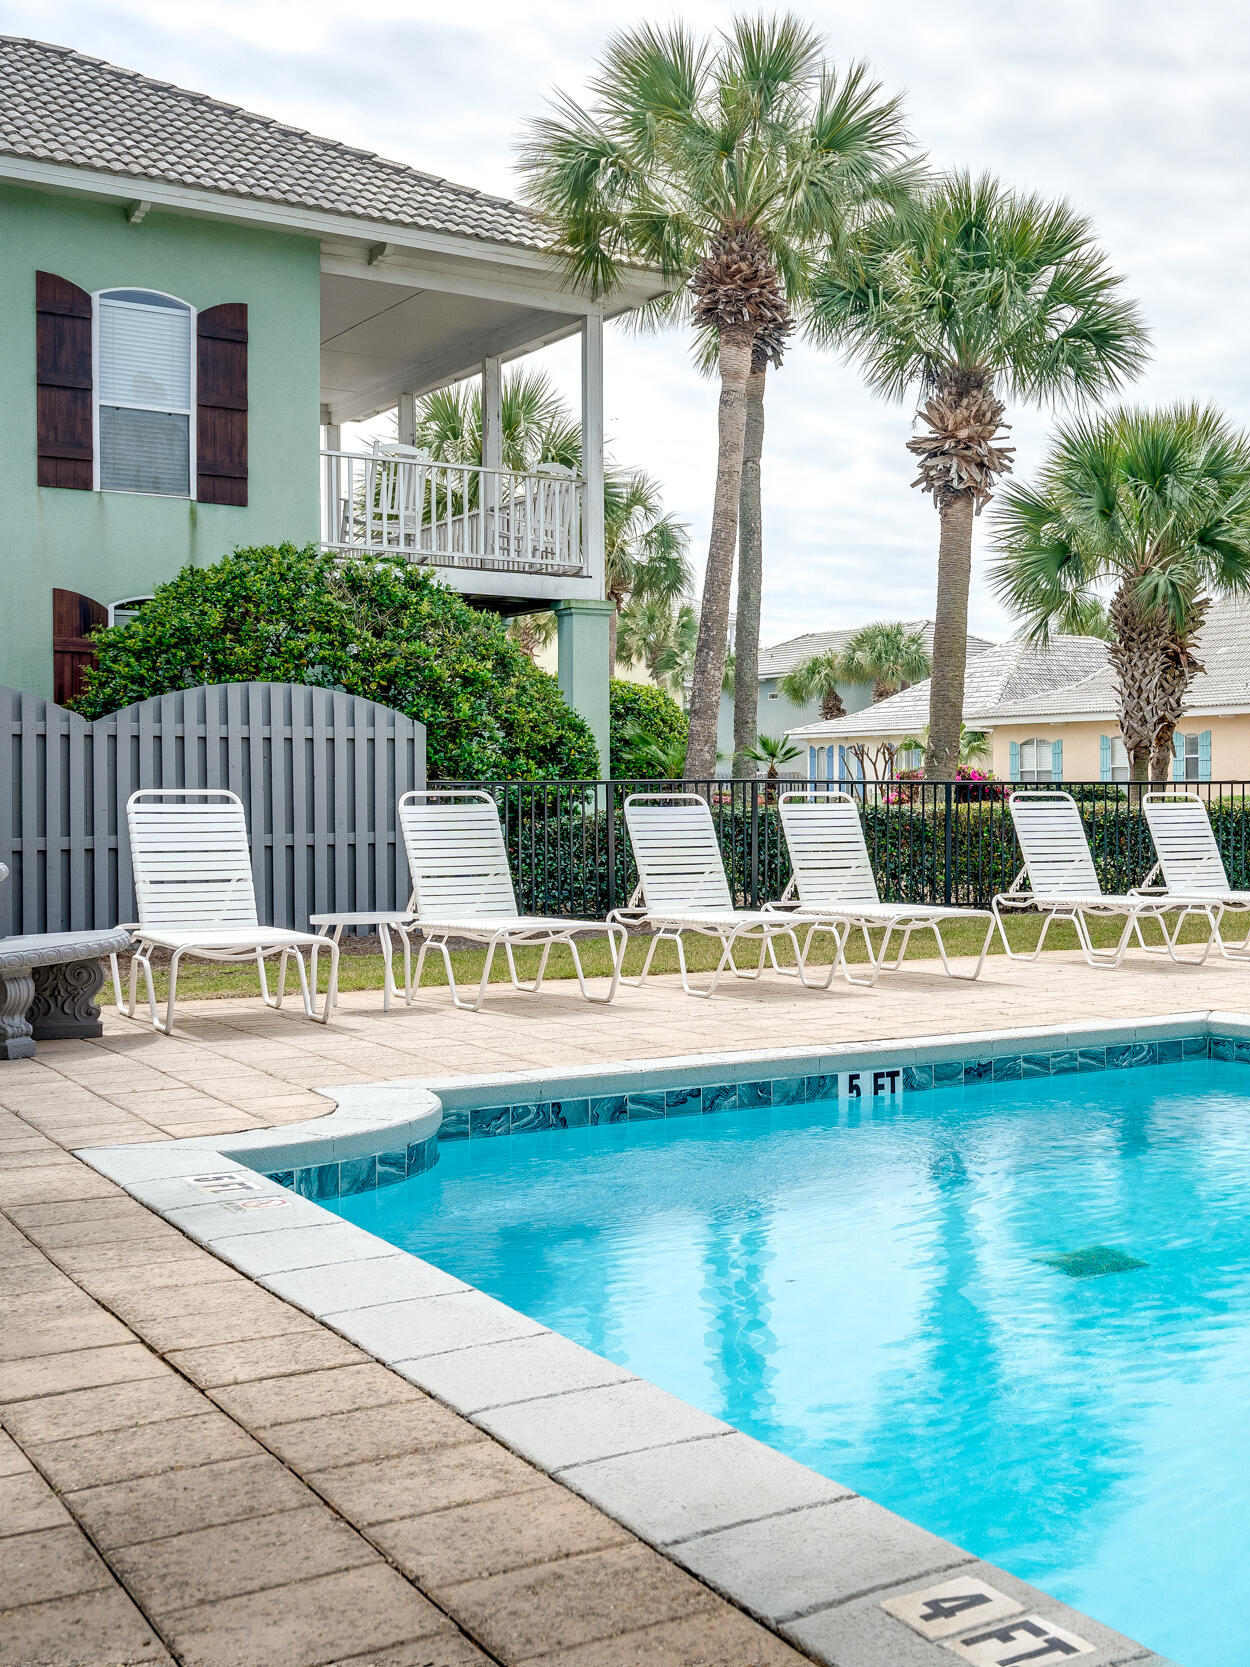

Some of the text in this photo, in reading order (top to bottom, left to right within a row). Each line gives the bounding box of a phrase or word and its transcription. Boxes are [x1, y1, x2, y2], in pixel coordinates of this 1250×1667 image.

[848, 1070, 900, 1098] 5 FT
[919, 1593, 993, 1623] 4
